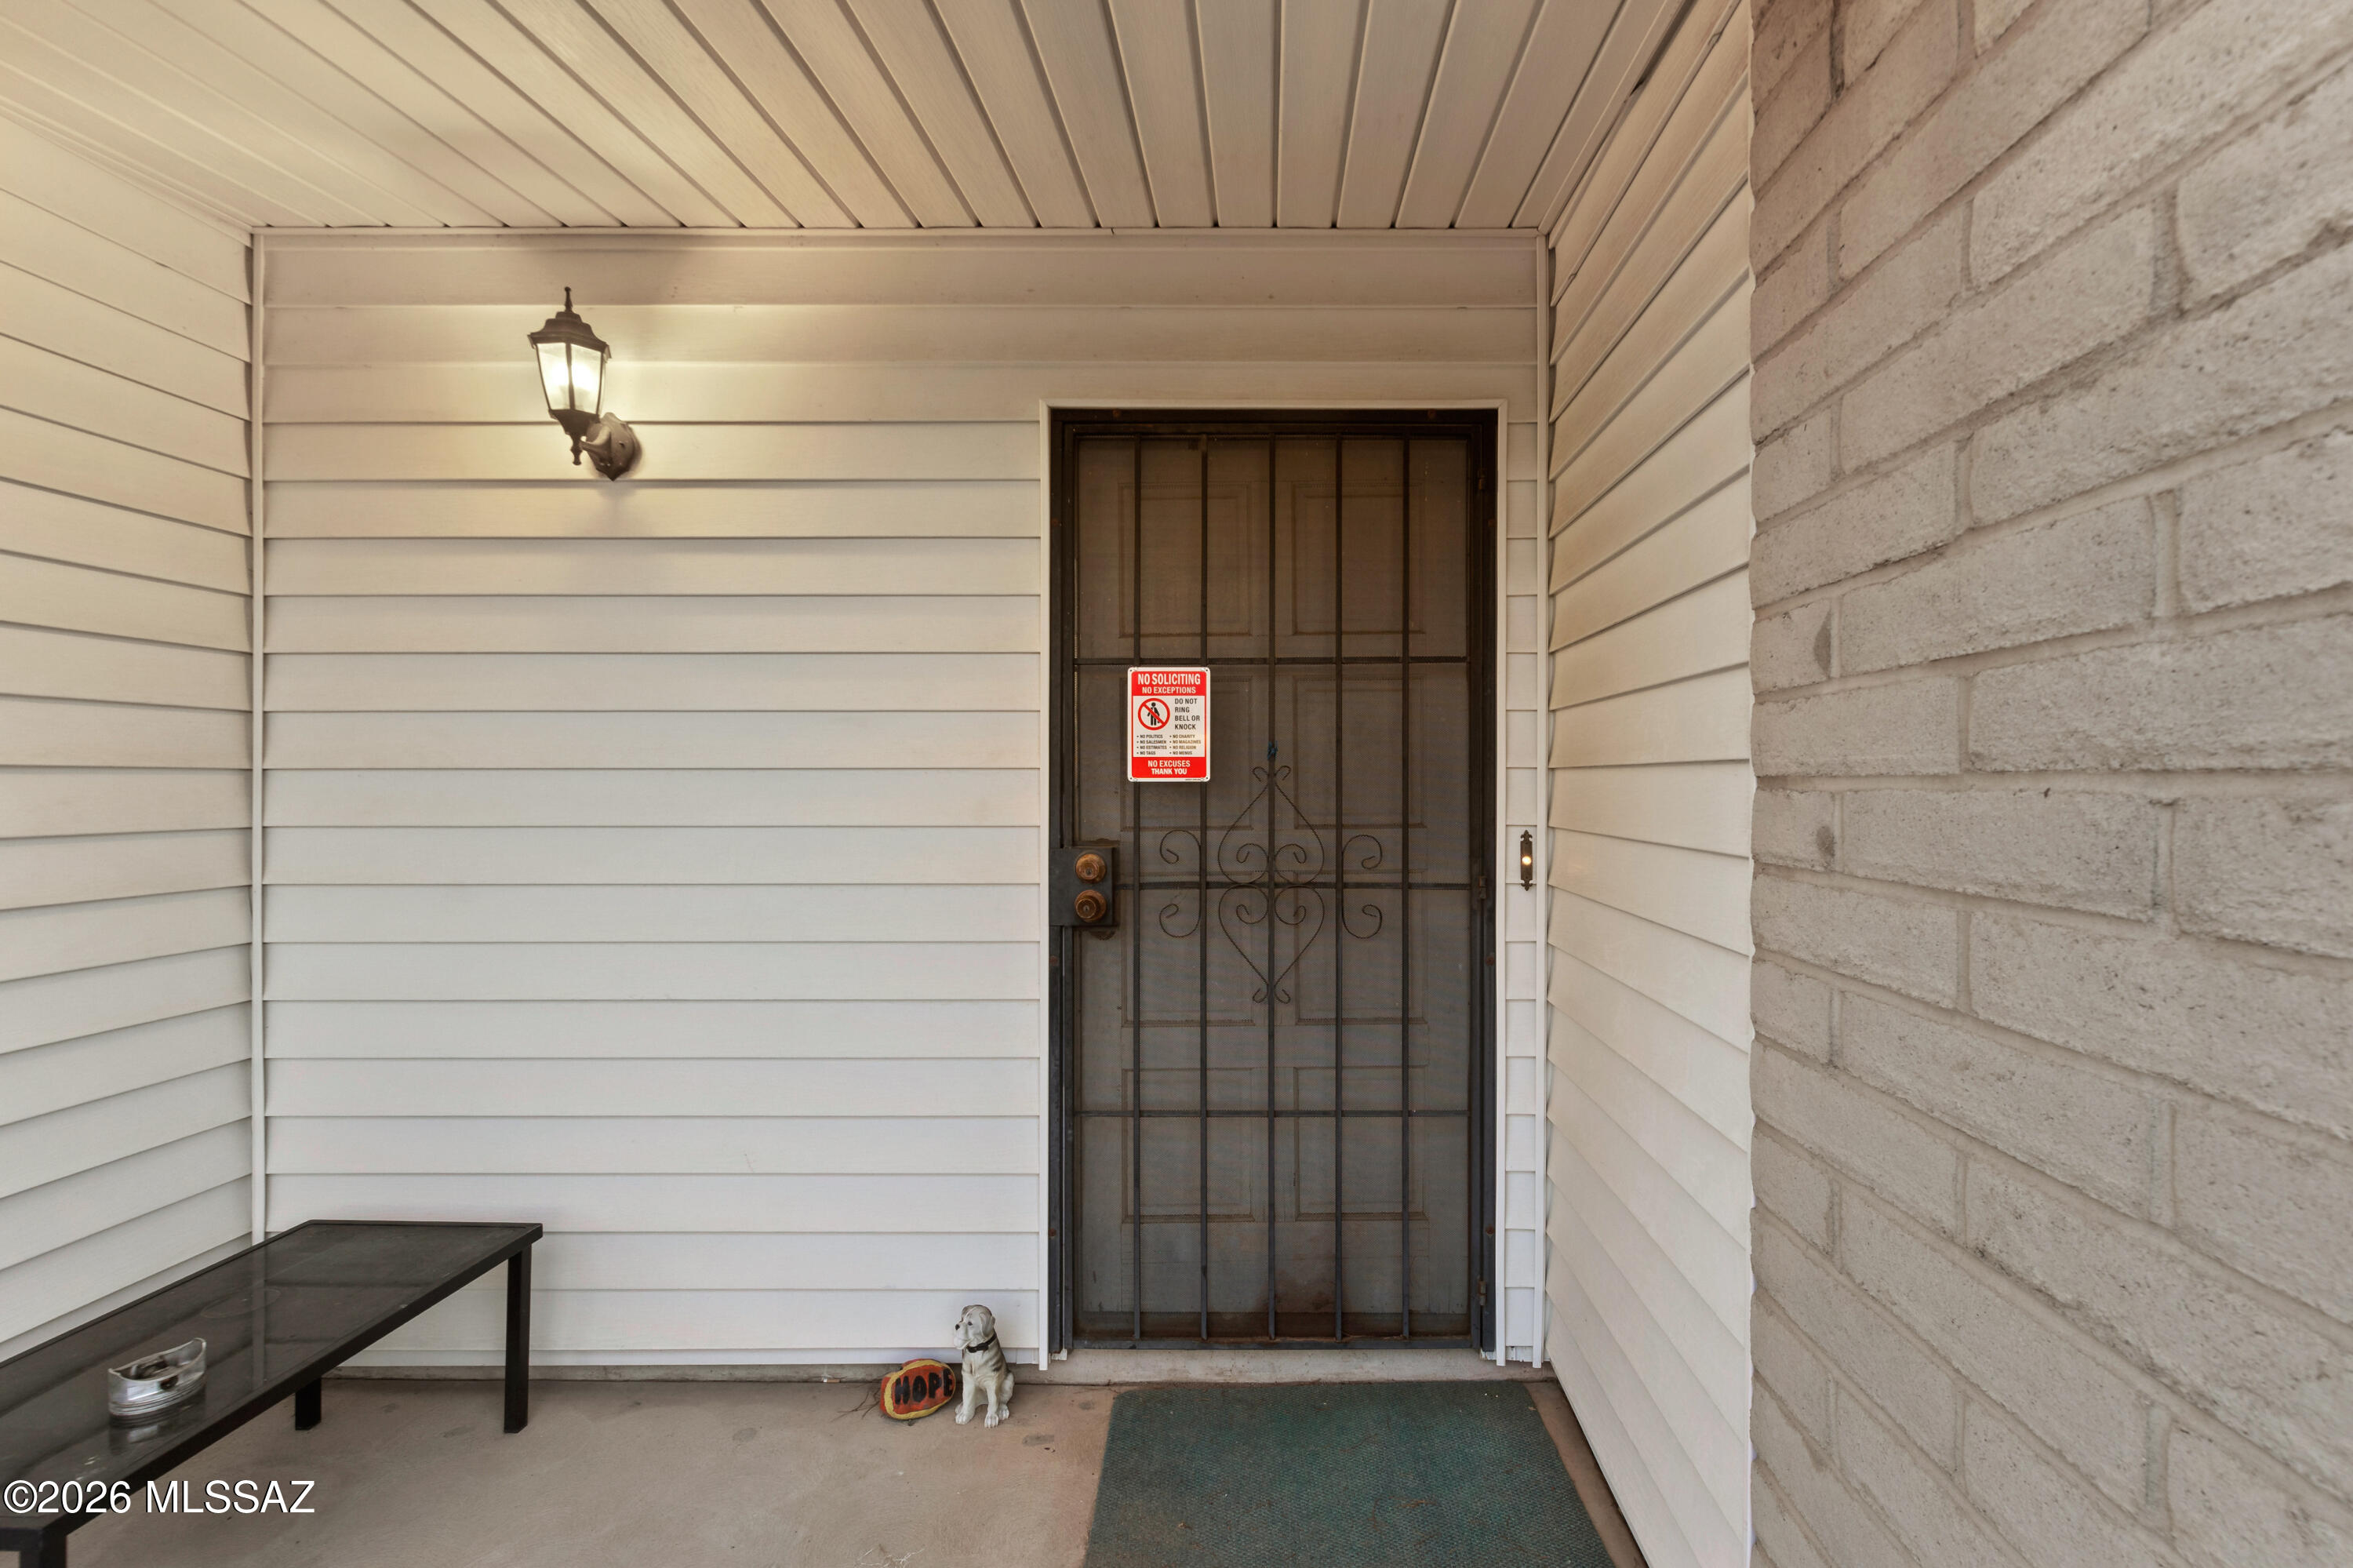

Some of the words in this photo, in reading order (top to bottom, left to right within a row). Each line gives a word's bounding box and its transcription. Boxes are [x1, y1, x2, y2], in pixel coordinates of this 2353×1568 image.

[1138, 674, 1150, 684] NO
[1152, 674, 1200, 684] SOLICITING
[894, 1368, 954, 1405] HOPE
